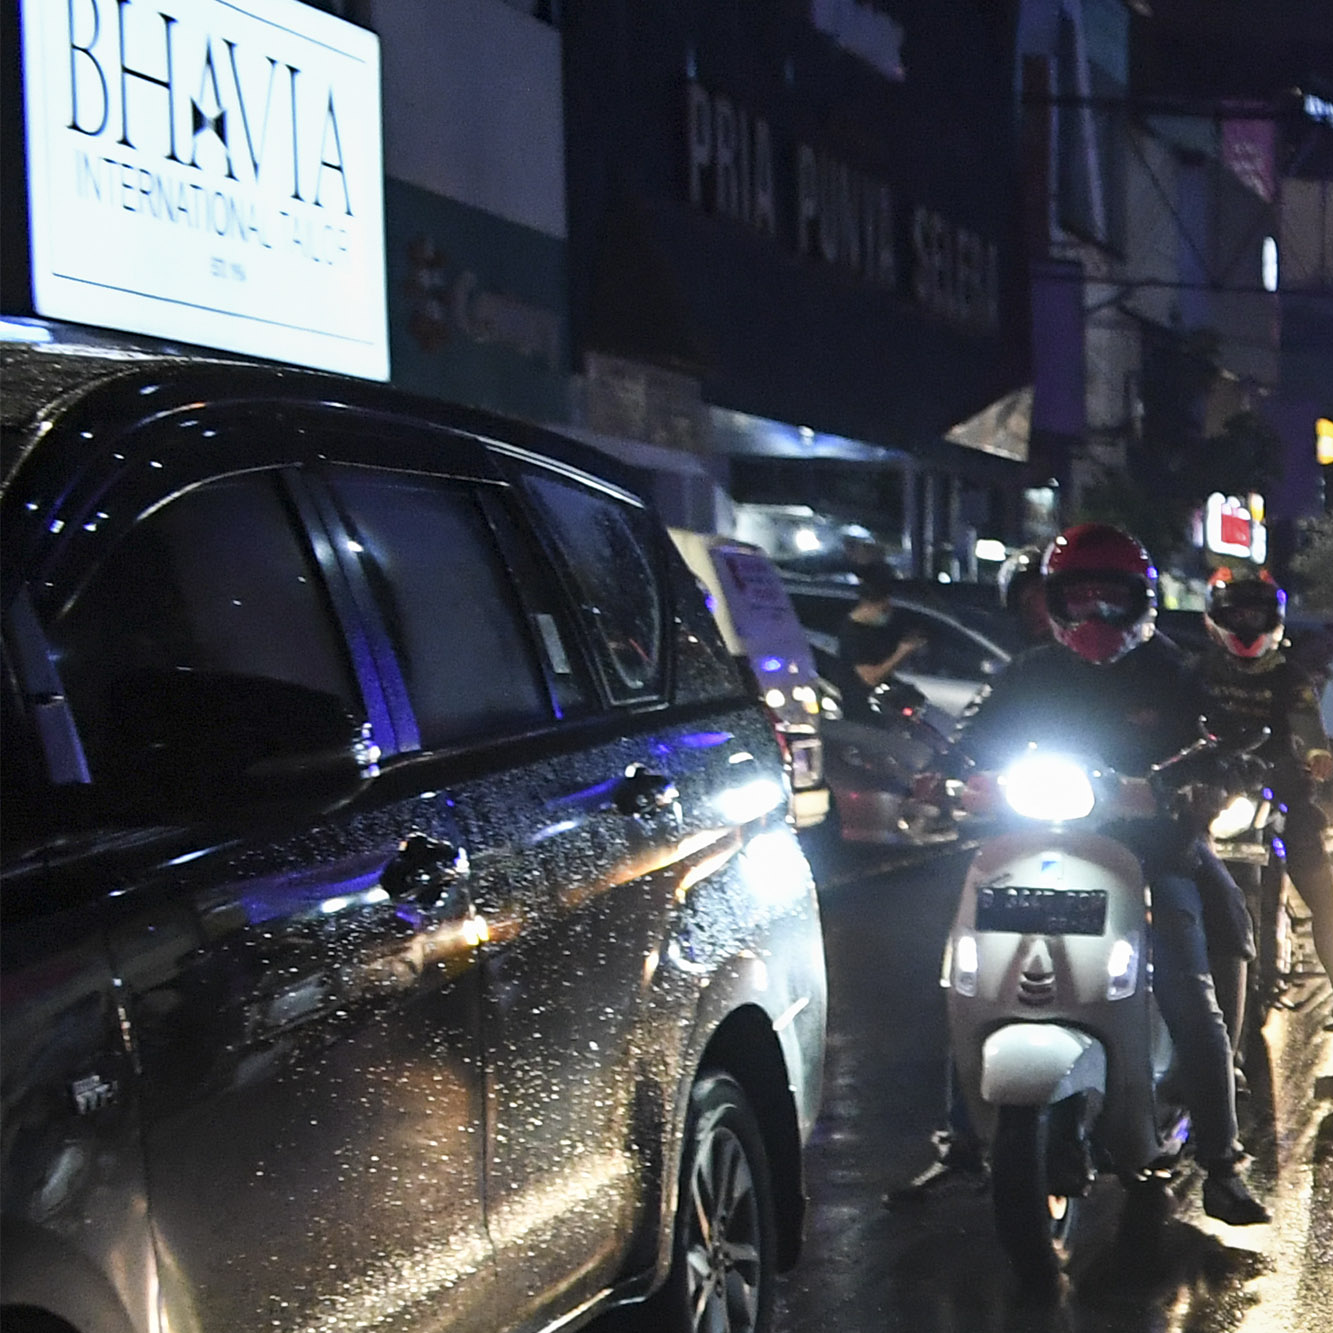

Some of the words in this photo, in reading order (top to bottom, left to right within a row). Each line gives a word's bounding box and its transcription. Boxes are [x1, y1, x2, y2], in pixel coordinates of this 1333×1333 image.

[64, 0, 354, 217] BHAVIA
[687, 82, 777, 239] PRIA
[74, 148, 273, 250] INTERNATIONAL
